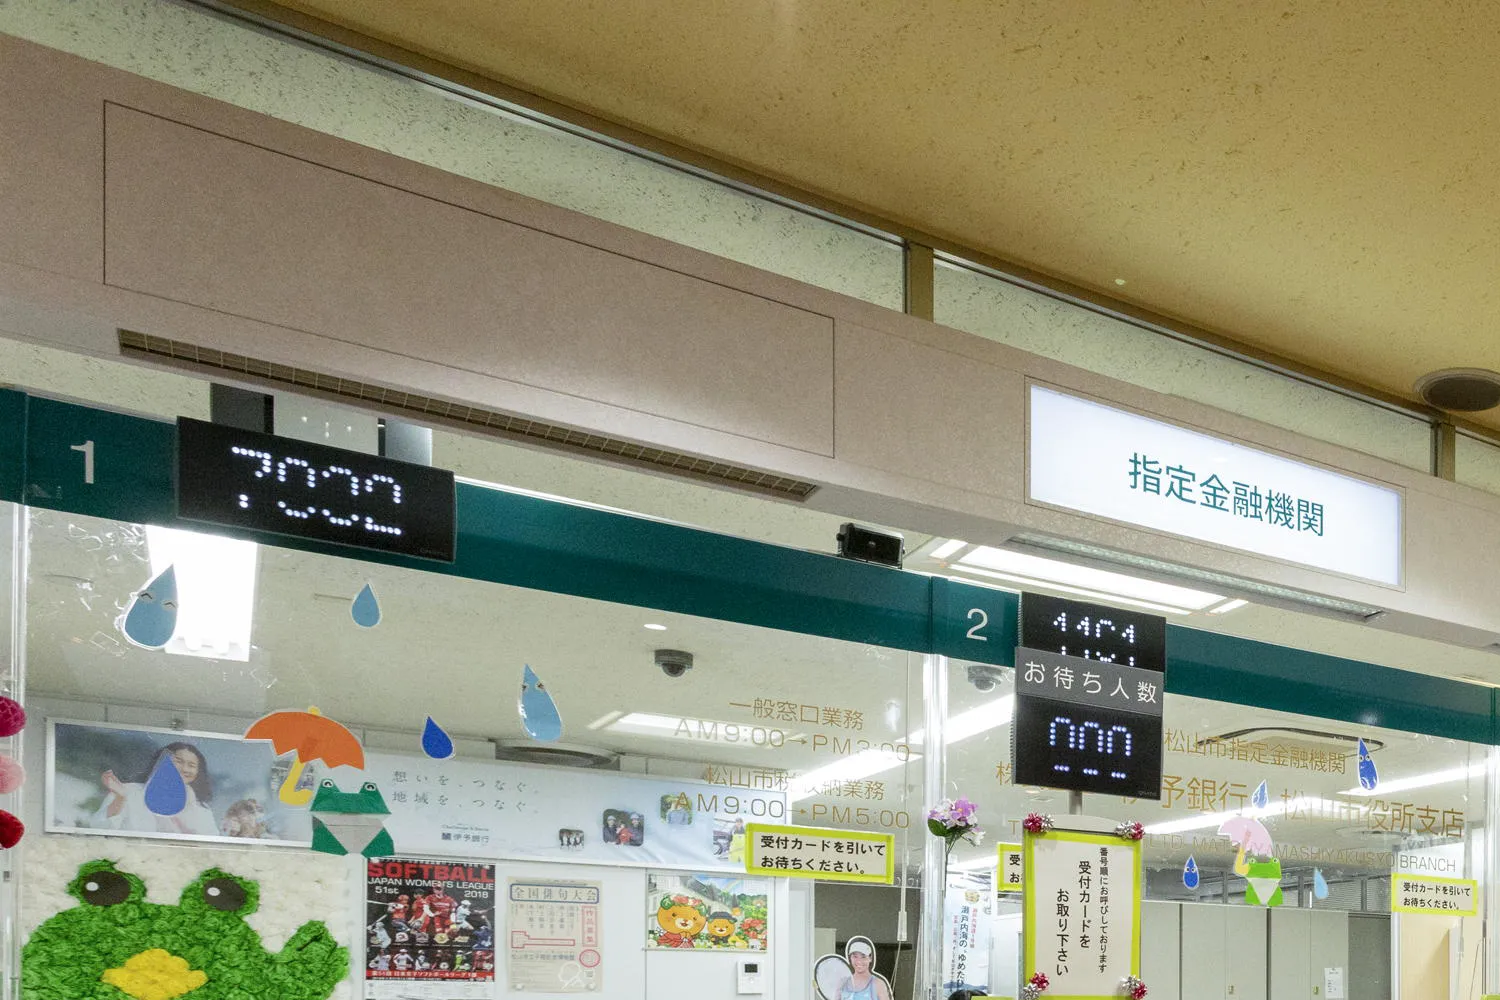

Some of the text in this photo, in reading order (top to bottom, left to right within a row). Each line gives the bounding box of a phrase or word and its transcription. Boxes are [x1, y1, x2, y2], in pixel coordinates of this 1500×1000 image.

[70, 440, 95, 484] 1
[1128, 452, 1324, 537] 指定金融機関
[966, 608, 988, 641] 2
[1024, 661, 1157, 704] お待ち人数
[729, 696, 865, 731] 一般窓口業務
[1163, 727, 1348, 776] 松山市指定金融機関
[1280, 787, 1465, 839] 松山市役所支店
[760, 835, 886, 856] 受付カードを引いて
[366, 862, 496, 883] SOFTBALL
[760, 855, 866, 875] お待ちください。
[1400, 854, 1457, 873] BRANCH
[368, 877, 403, 887] JAPAN
[456, 882, 495, 891] LEAGUE
[375, 885, 489, 898] 51st 2018
[1402, 882, 1471, 897] 受付カードを引いて
[1078, 861, 1092, 949] 受付カードを
[1099, 847, 1109, 974] 番号順にお呼びしております
[1402, 897, 1460, 911] お待ちください。
[1056, 888, 1070, 976] お取り下さい
